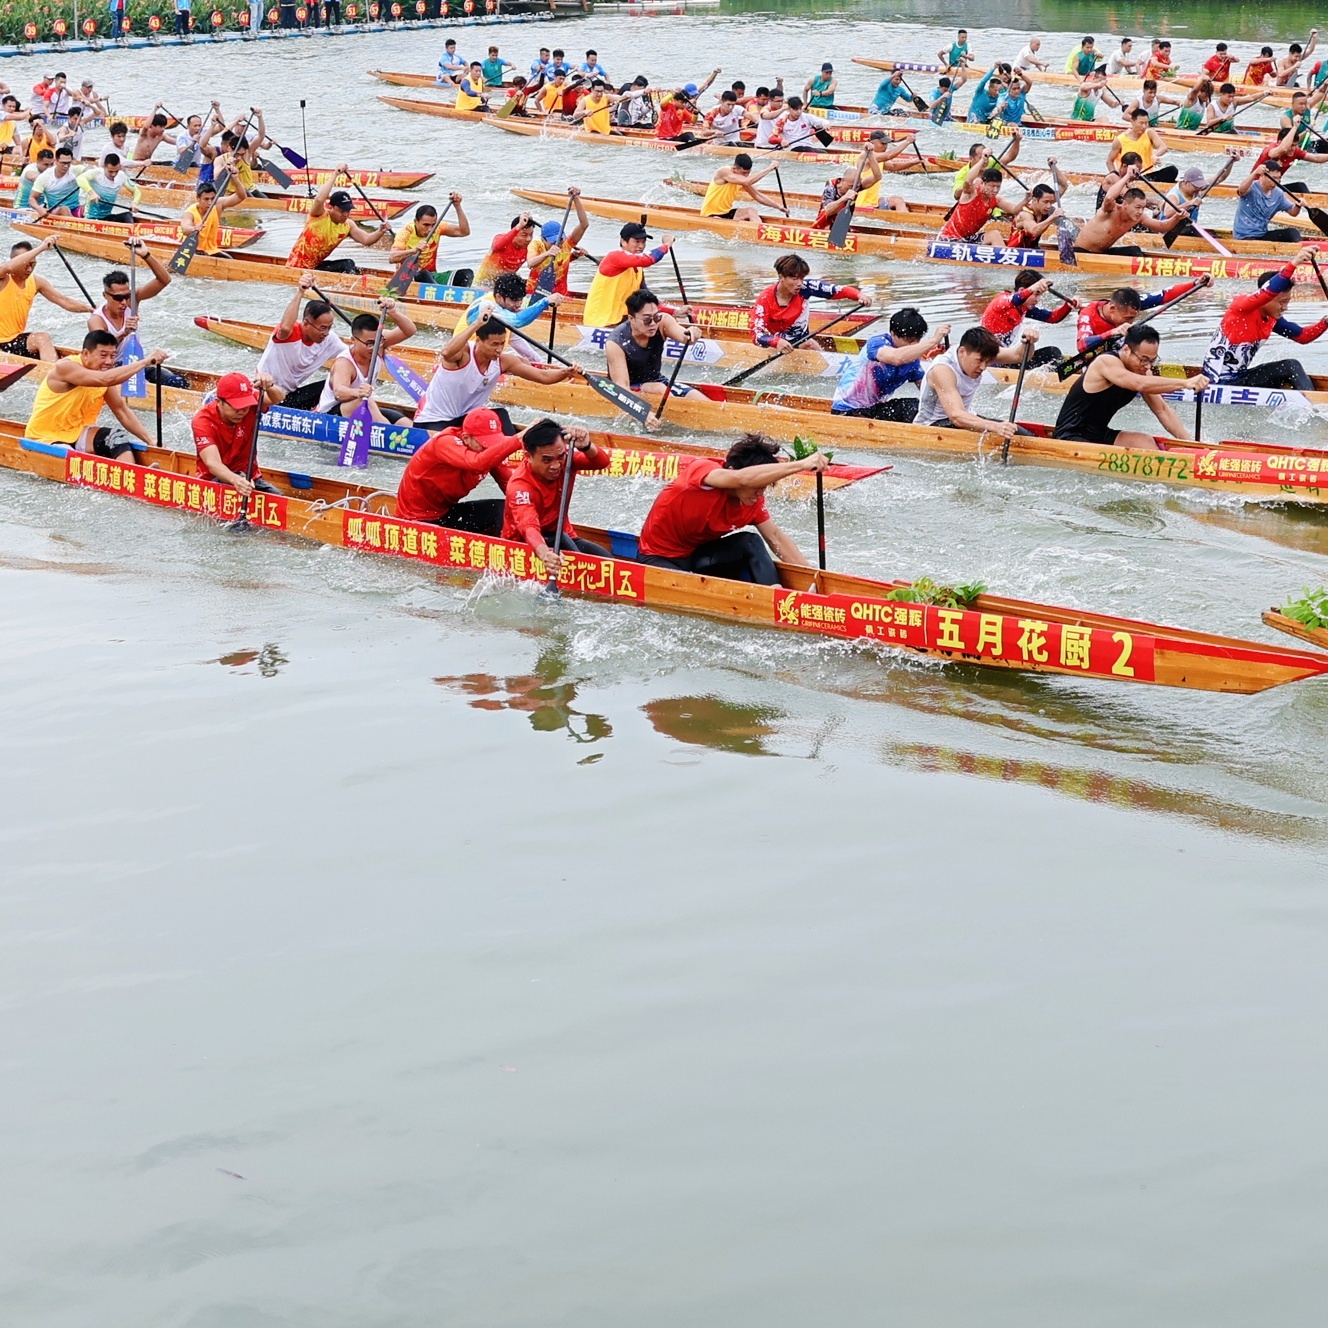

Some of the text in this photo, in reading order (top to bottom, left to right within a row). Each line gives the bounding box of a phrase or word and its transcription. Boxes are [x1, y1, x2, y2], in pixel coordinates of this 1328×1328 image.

[55, 22, 66, 32] 40
[85, 22, 95, 32] 41
[150, 18, 160, 28] 43
[27, 25, 38, 36] 39
[366, 172, 378, 187] 22
[221, 228, 232, 247] 18
[1135, 257, 1153, 277] 23
[800, 602, 847, 624] 能强瓷砖
[935, 608, 1093, 671] 五月花厨
[1111, 630, 1136, 677] 2
